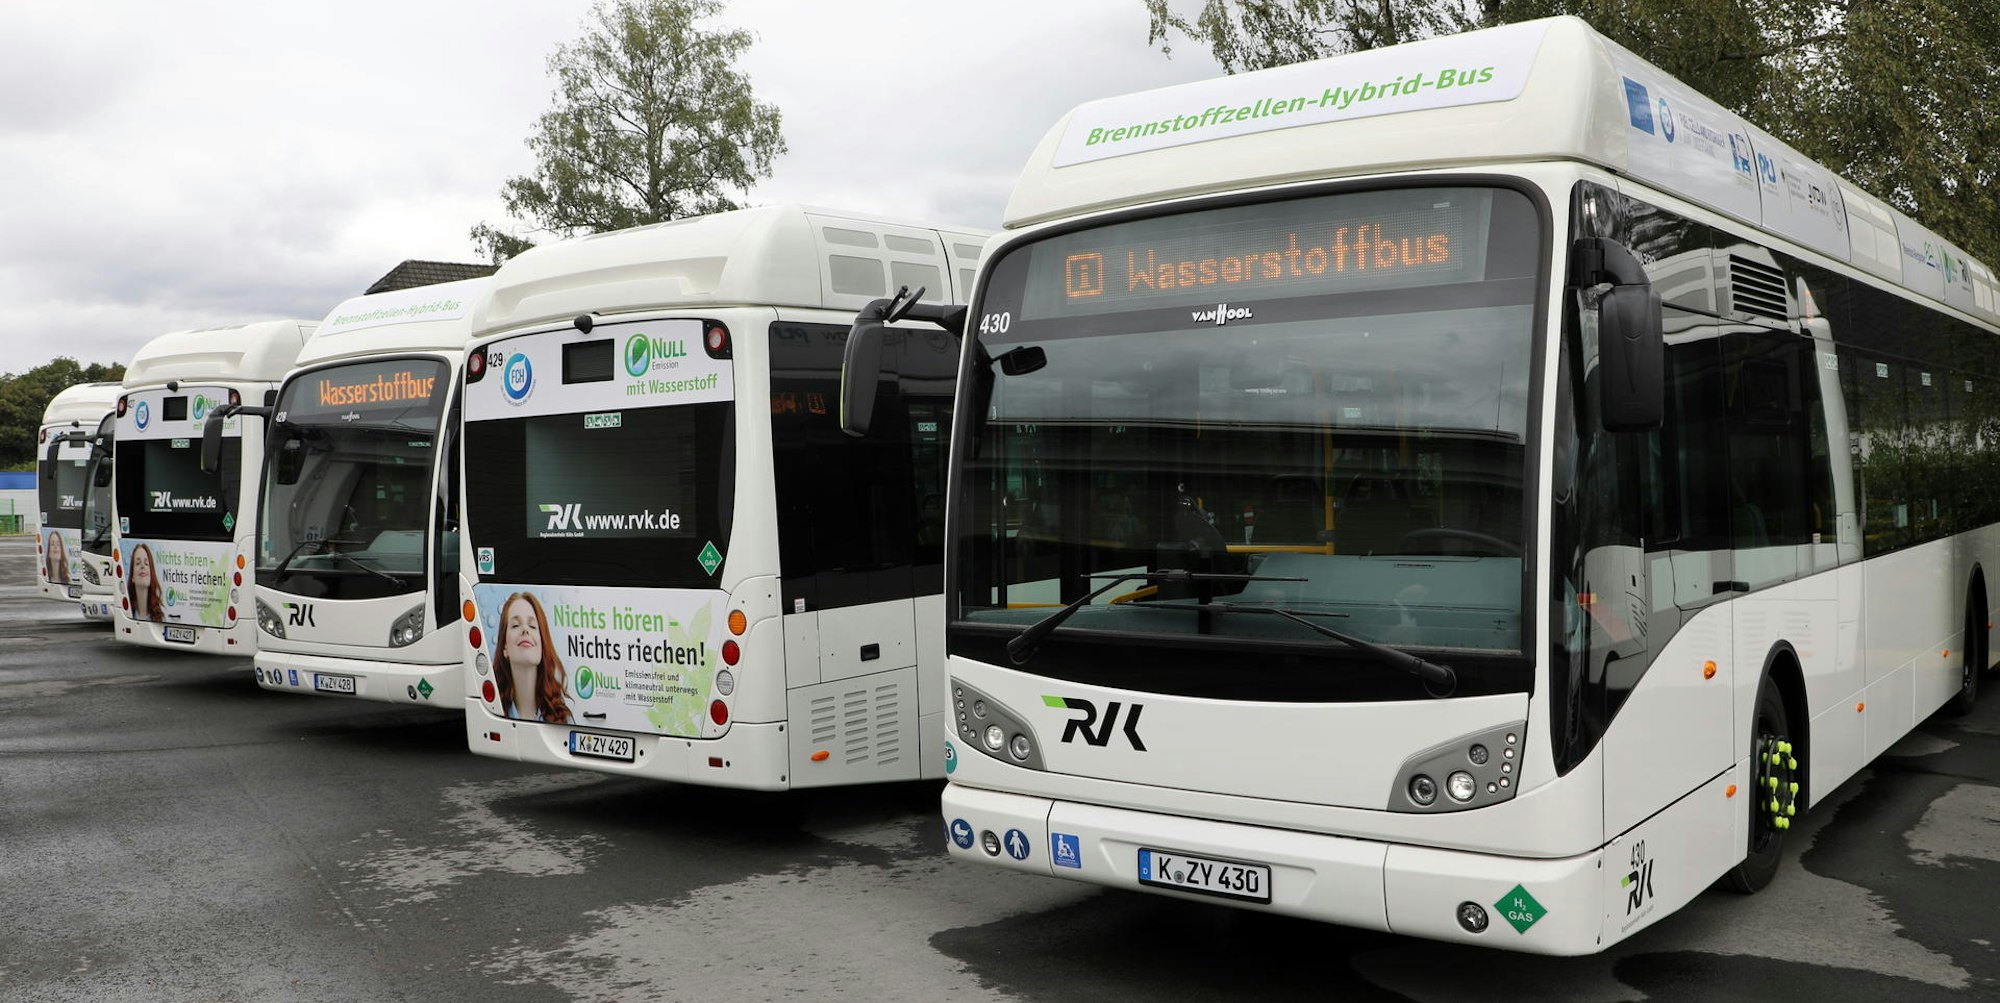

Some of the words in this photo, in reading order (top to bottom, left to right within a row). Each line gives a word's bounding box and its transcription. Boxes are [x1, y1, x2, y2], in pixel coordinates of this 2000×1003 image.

[1085, 63, 1495, 147] Brennstoffzellen-Hybrid-Bus
[1128, 224, 1449, 291] Wasserstoffbus
[979, 311, 1011, 334] 430
[488, 352, 504, 368] 429
[652, 360, 679, 371] Emission
[511, 368, 525, 384] FCH
[626, 379, 646, 396] mit
[649, 373, 718, 394] Wasserstoff
[319, 371, 435, 406] Wasserstoffbus
[172, 496, 217, 508] www.rvk.de
[539, 503, 583, 530] RVK
[585, 509, 680, 530] www.rvk.de
[163, 569, 188, 584] Nichts
[191, 570, 226, 587] riechen!
[283, 602, 316, 627] RVK
[553, 604, 606, 629] Nichts
[613, 607, 664, 632] hören
[568, 634, 621, 661] Nichts
[628, 638, 706, 667] riechen!
[624, 669, 666, 681] Emissionsfrei
[668, 673, 680, 682] und
[625, 681, 665, 693] klimaneutral
[665, 685, 699, 696] unterwegs
[625, 693, 637, 702] mit
[637, 693, 674, 705] Wasserstoff
[1041, 695, 1148, 752] RVK
[580, 735, 586, 751] K
[608, 739, 629, 756] 429
[1630, 839, 1646, 870] 430
[1159, 857, 1172, 881] K
[1218, 866, 1260, 893] 430
[1620, 858, 1655, 916] RVK
[1508, 910, 1534, 923] GAS
